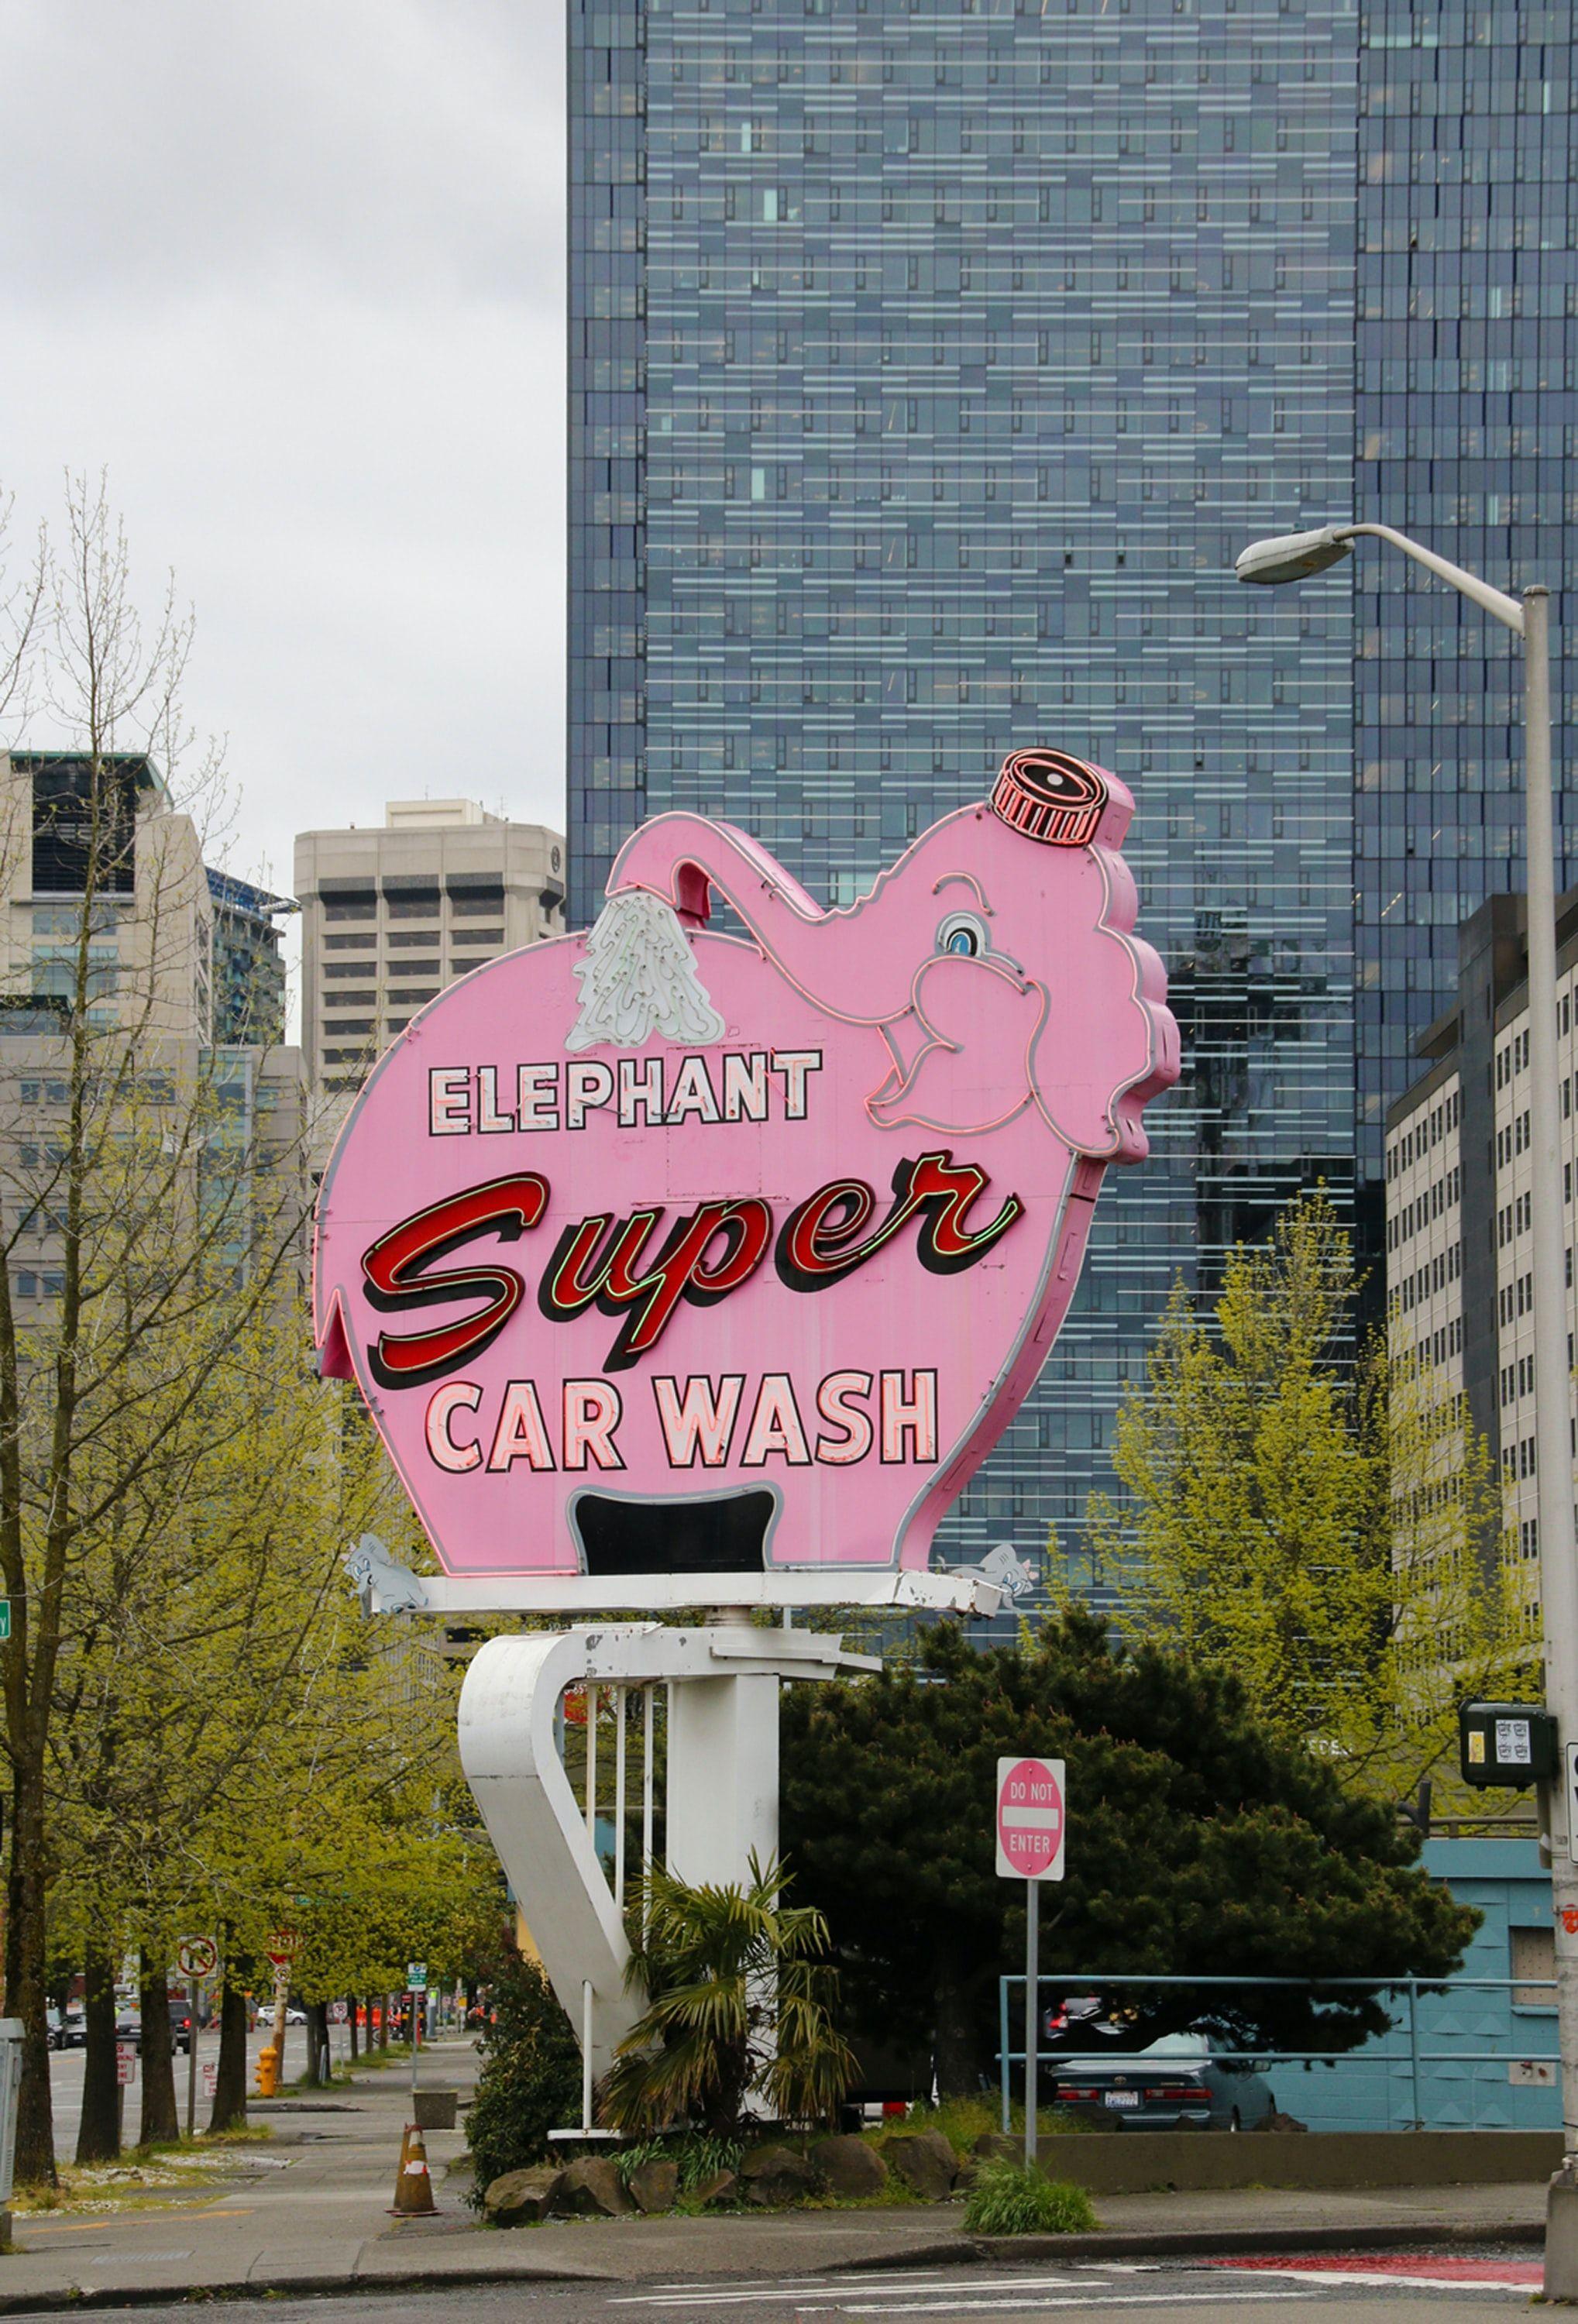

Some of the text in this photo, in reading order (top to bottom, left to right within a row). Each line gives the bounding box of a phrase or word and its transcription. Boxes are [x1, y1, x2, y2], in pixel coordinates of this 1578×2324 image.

[428, 1049, 823, 1136] ELEPHANT
[361, 1150, 1025, 1387] Super
[425, 1369, 938, 1473] CAR WASH
[1010, 1783, 1053, 1800] DO NOT
[1009, 1834, 1050, 1853] ENTER
